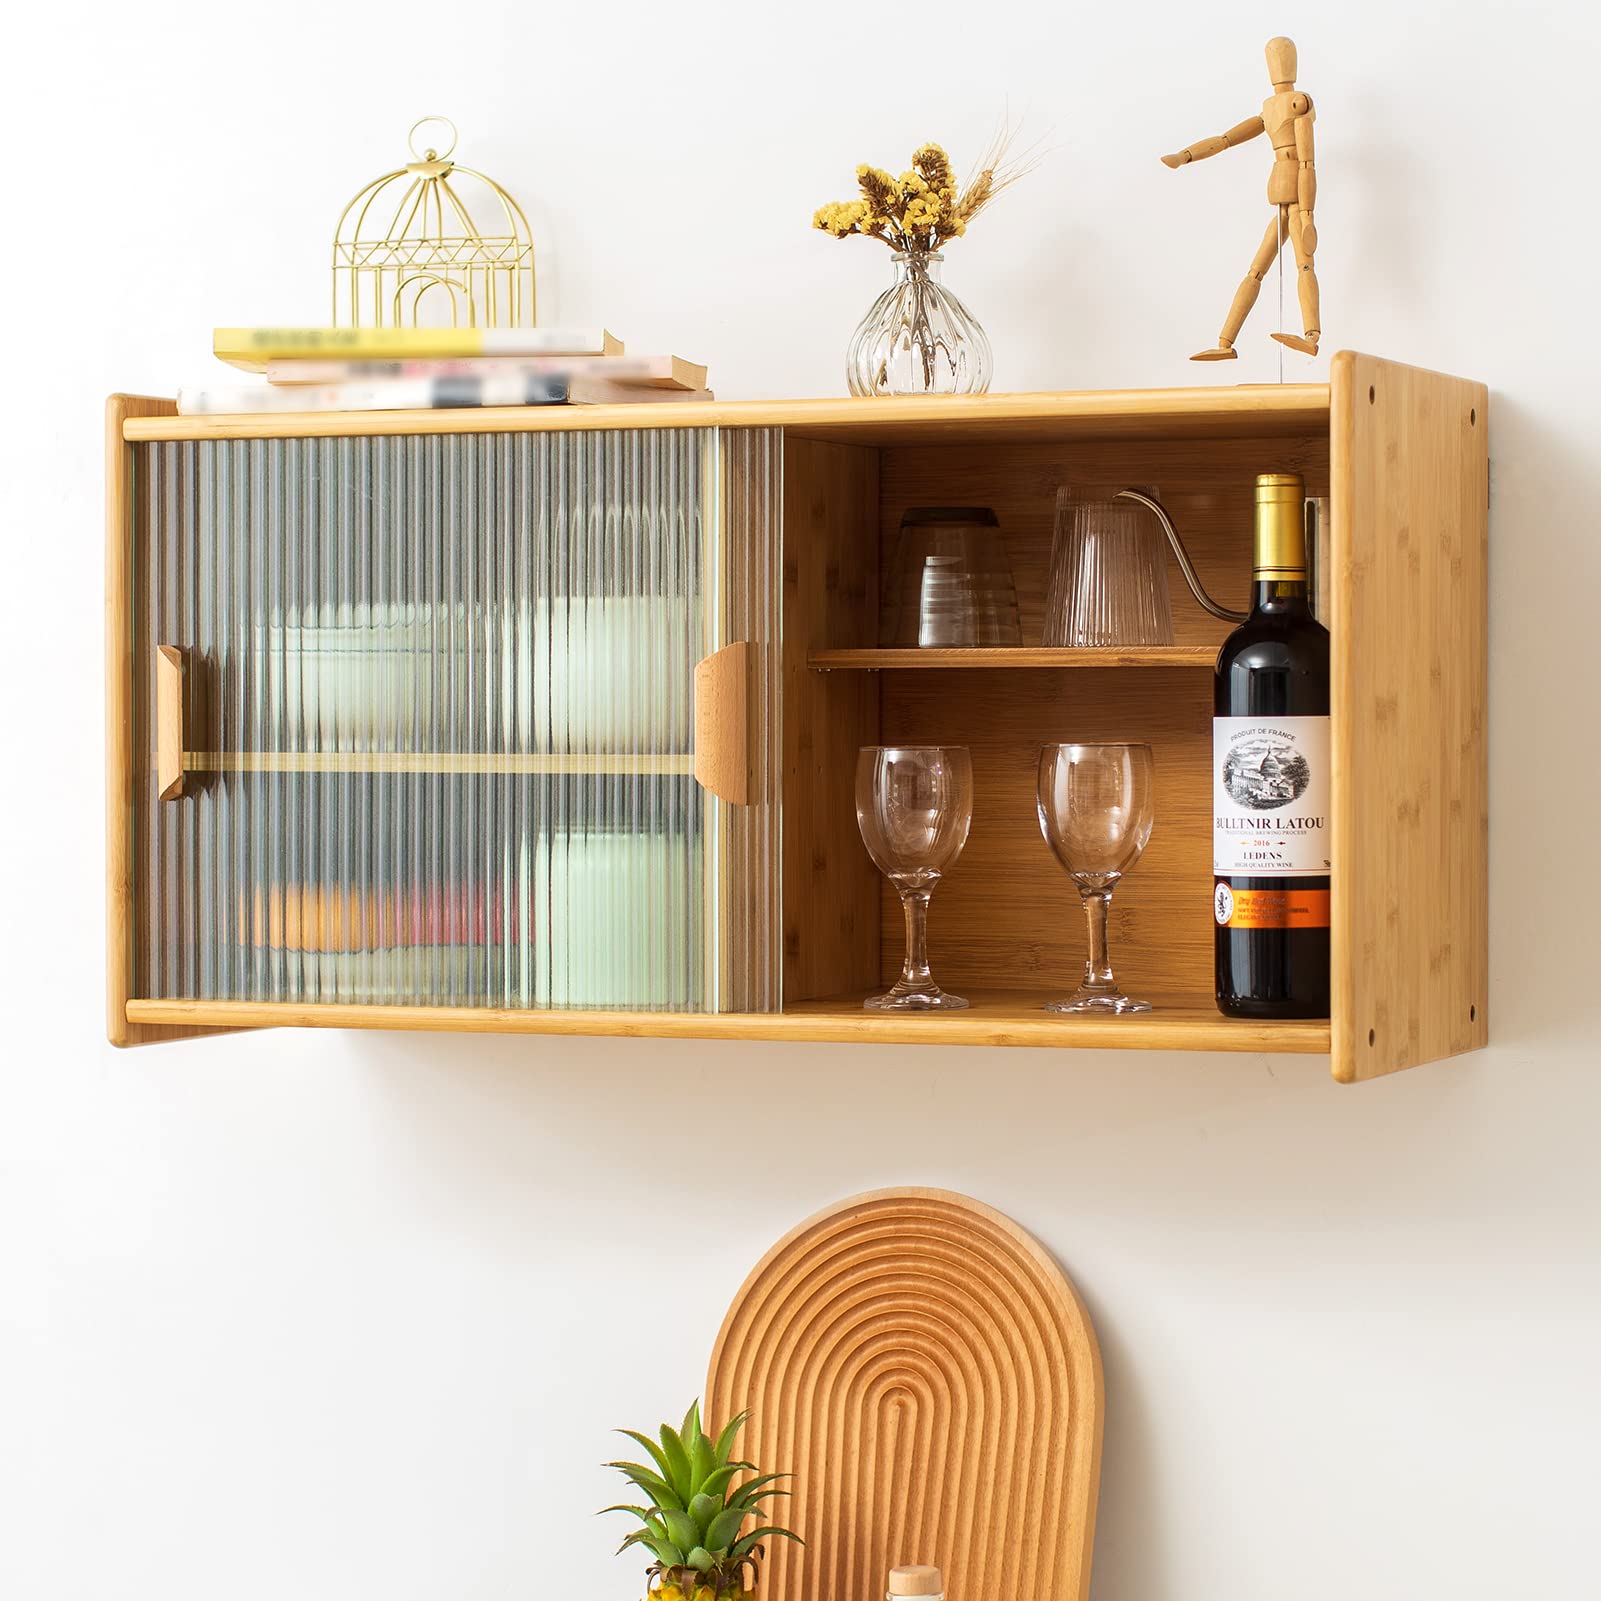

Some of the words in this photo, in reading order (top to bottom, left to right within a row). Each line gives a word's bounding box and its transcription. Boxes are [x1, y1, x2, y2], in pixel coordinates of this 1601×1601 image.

[1230, 728, 1256, 742] PRODUIT
[1268, 728, 1297, 742] FRANCE
[1276, 817, 1325, 829] LATOU
